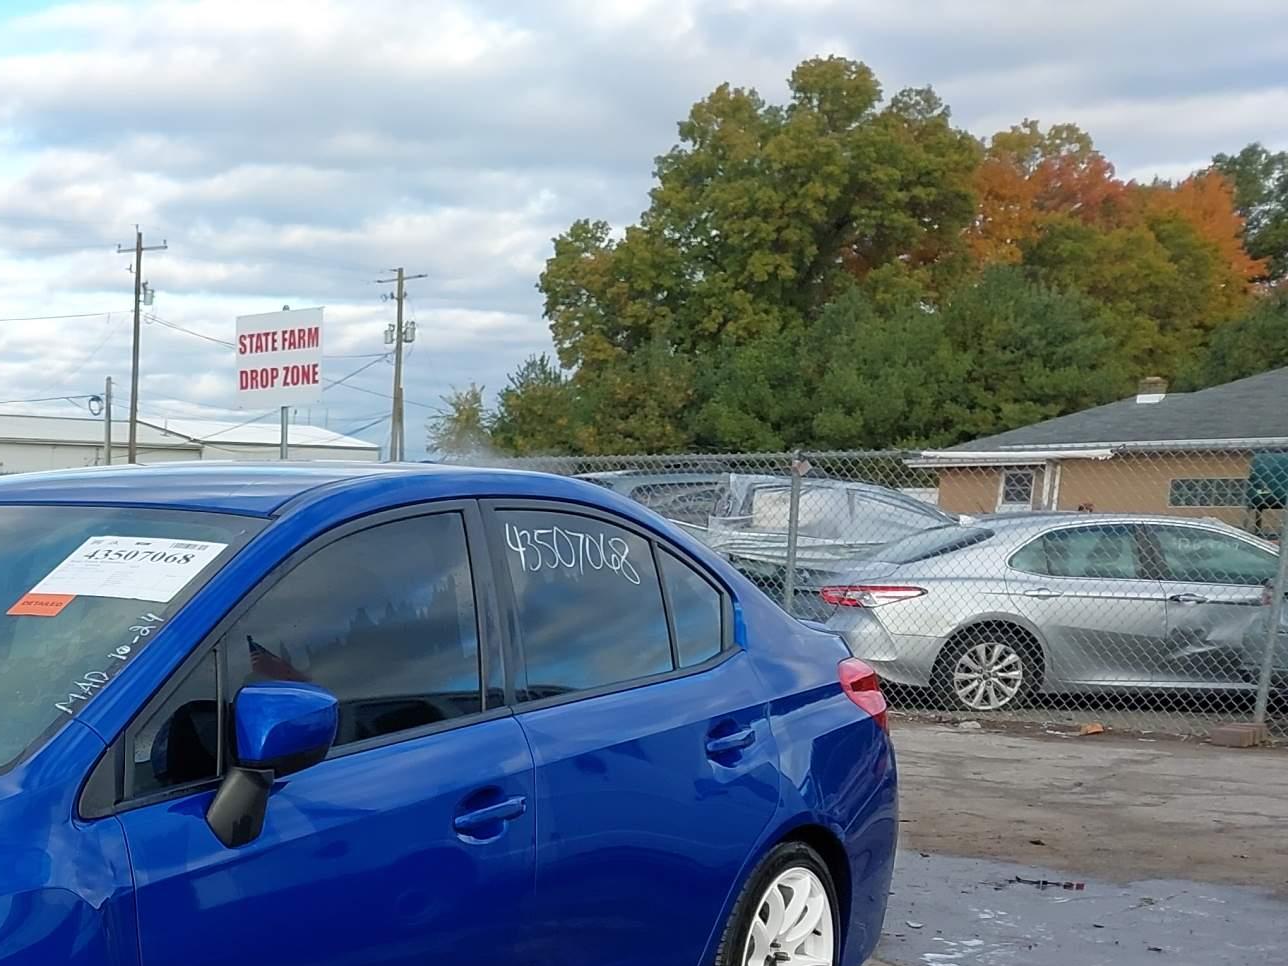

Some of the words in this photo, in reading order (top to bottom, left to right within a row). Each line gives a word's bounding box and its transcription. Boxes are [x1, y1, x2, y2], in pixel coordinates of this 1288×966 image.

[239, 331, 278, 354] STATE
[281, 327, 319, 350] FARM
[239, 367, 279, 390] DROP
[282, 363, 319, 386] ZONE
[83, 548, 196, 565] 43507068
[505, 522, 641, 585] 43507068
[54, 671, 110, 714] MAD
[106, 612, 165, 660] 10-24
